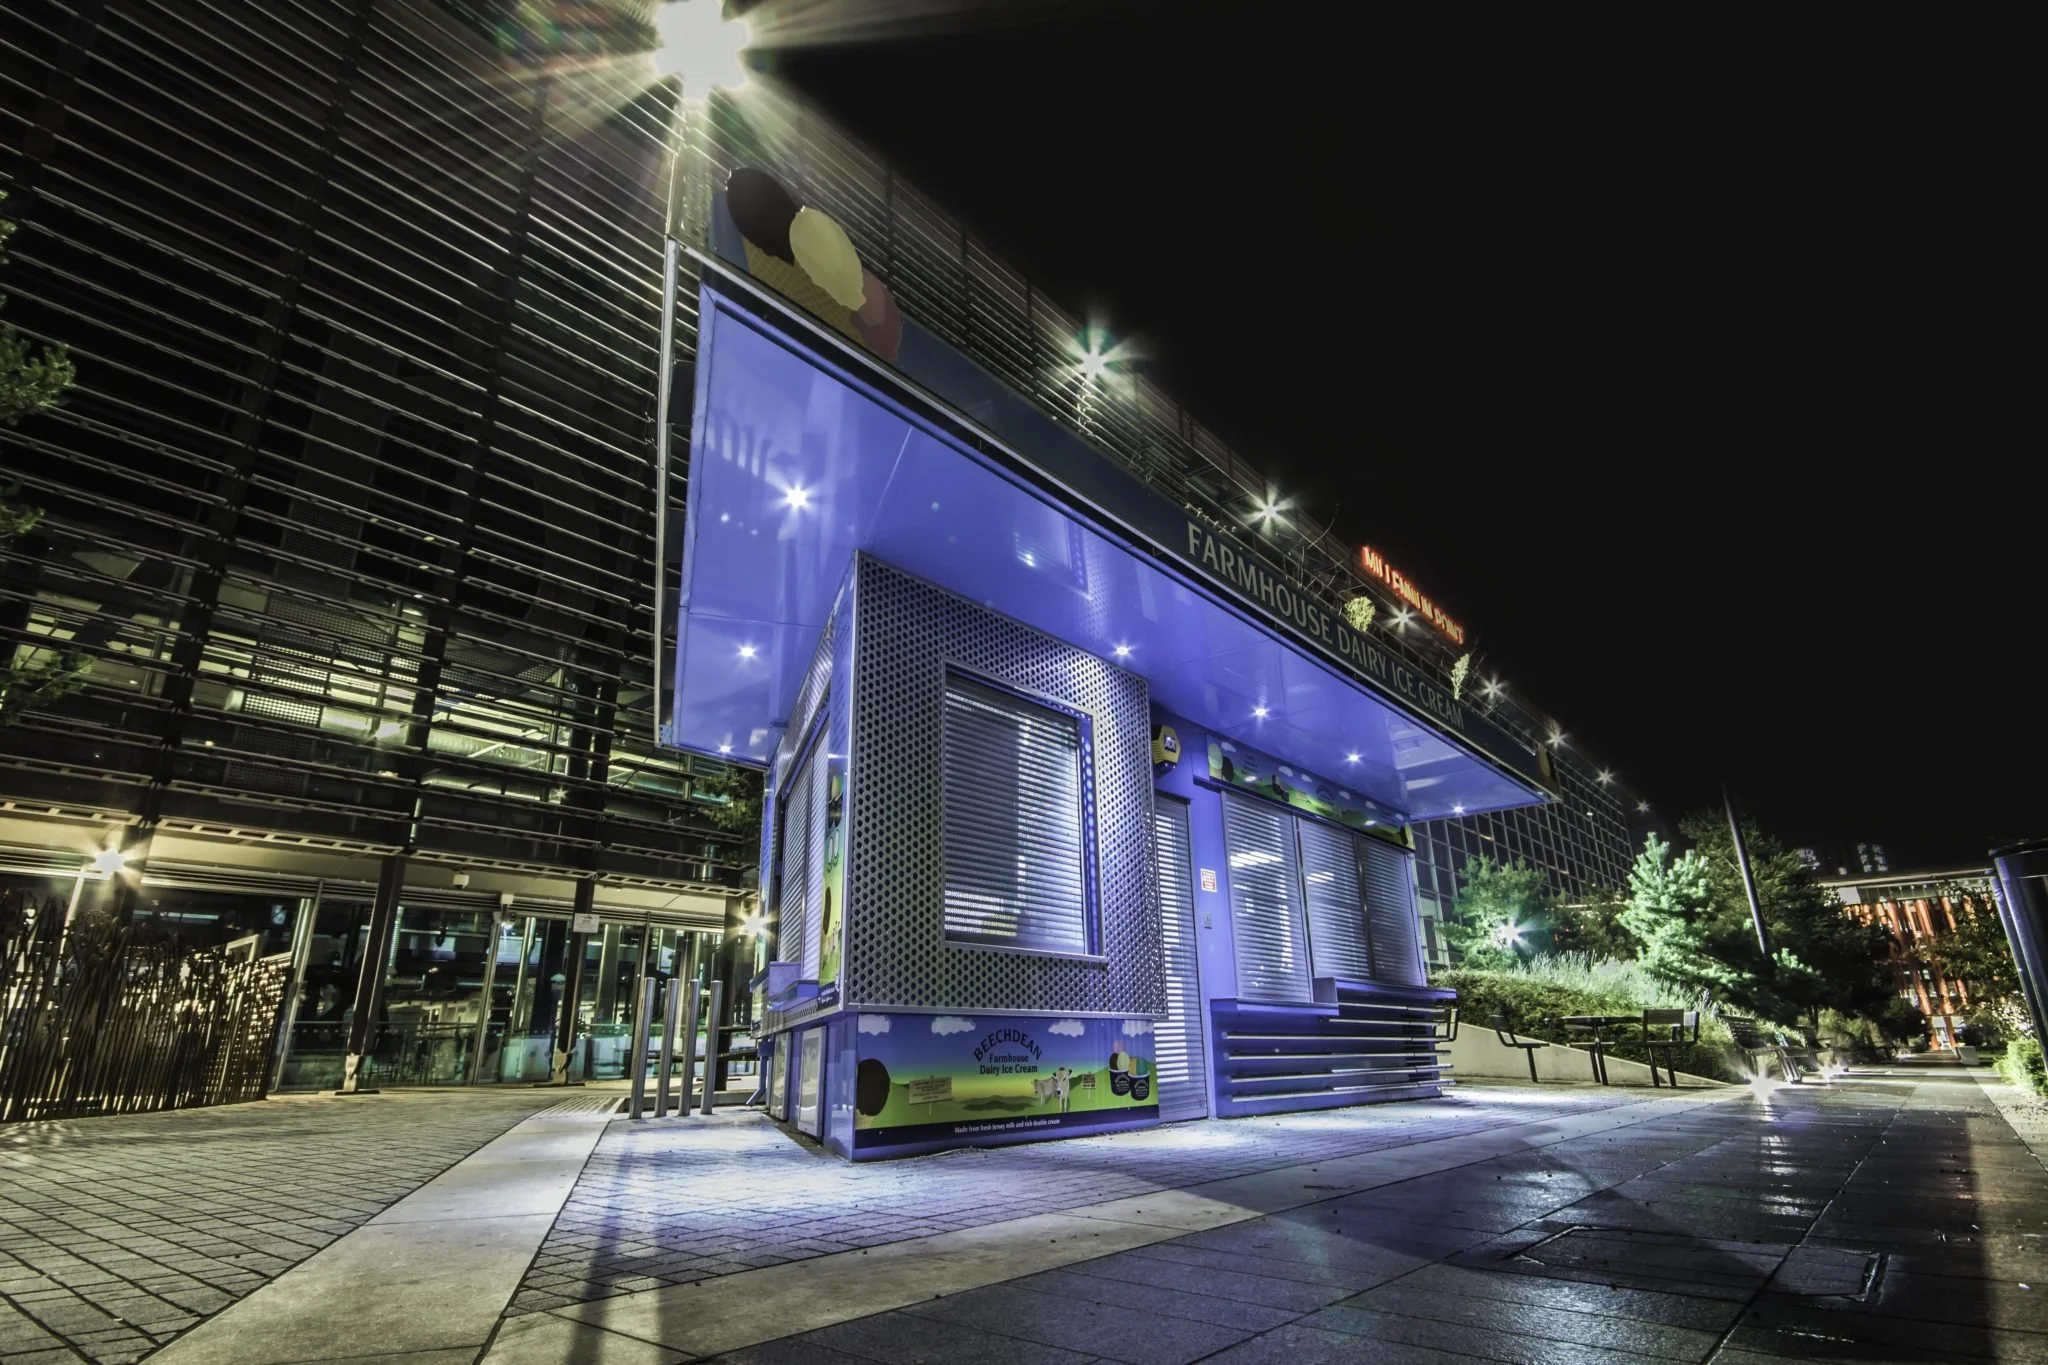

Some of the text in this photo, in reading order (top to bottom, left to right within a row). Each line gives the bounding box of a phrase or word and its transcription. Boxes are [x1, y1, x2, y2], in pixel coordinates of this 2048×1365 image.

[1187, 522, 1465, 731] FARMHOUSE DAIRY ICE CREAM
[973, 1028, 1043, 1062] BEECHDEAN
[989, 1052, 1029, 1063] Farmhouse
[980, 1063, 1038, 1076] Dairy Ice Cream
